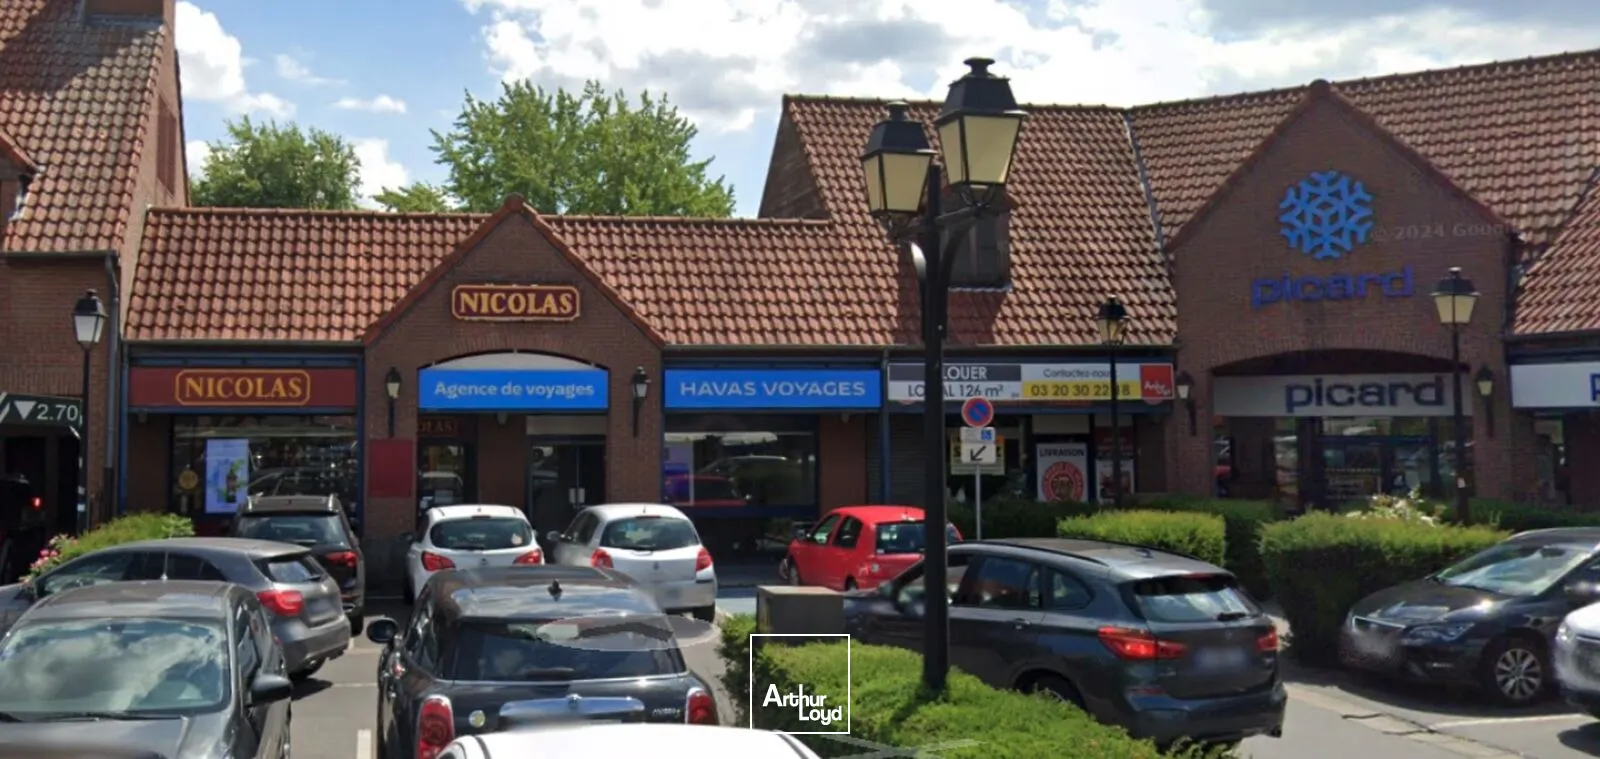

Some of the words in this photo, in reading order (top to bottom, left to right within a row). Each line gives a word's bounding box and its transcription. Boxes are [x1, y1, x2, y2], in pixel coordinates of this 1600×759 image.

[1253, 265, 1415, 310] picard
[460, 293, 573, 314] NICOLAS
[1043, 368, 1112, 379] Contactez-nou
[185, 377, 302, 398] NICOLAS
[435, 381, 497, 399] Agence
[501, 381, 523, 396] de
[526, 383, 595, 399] voyages
[680, 382, 756, 396] HAVAS
[762, 382, 866, 396] VOYAGES
[960, 385, 982, 397] 126
[1031, 384, 1048, 396] 03
[1052, 384, 1069, 396] 20
[1072, 384, 1090, 396] 30
[1094, 384, 1110, 396] 22
[1285, 375, 1446, 414] picard
[37, 403, 79, 421] 2.70
